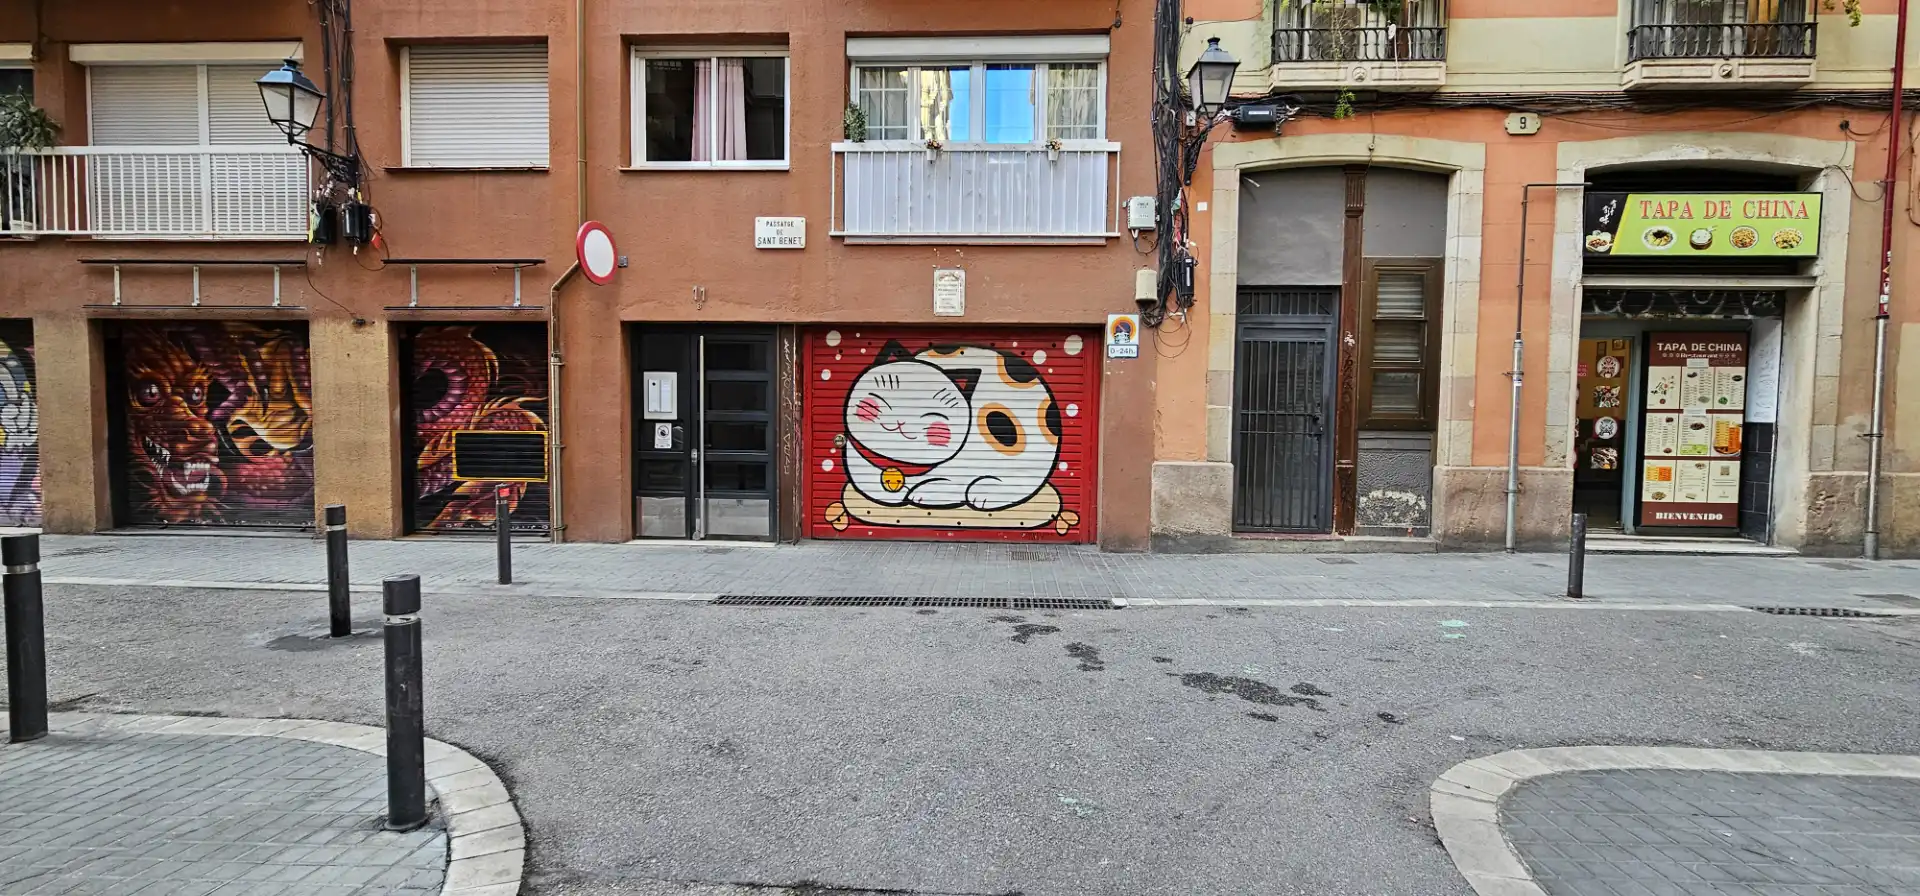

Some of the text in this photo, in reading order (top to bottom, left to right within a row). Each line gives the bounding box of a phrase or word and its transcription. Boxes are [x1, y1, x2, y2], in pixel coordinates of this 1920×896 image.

[1519, 116, 1527, 130] 9
[1639, 200, 1809, 219] TAPA DE CHINA
[765, 220, 794, 228] PASSATGE
[757, 236, 802, 245] SANT BENET
[1656, 342, 1742, 352] TAPA DE CHINA
[1655, 511, 1723, 521] BIENVENIDO
